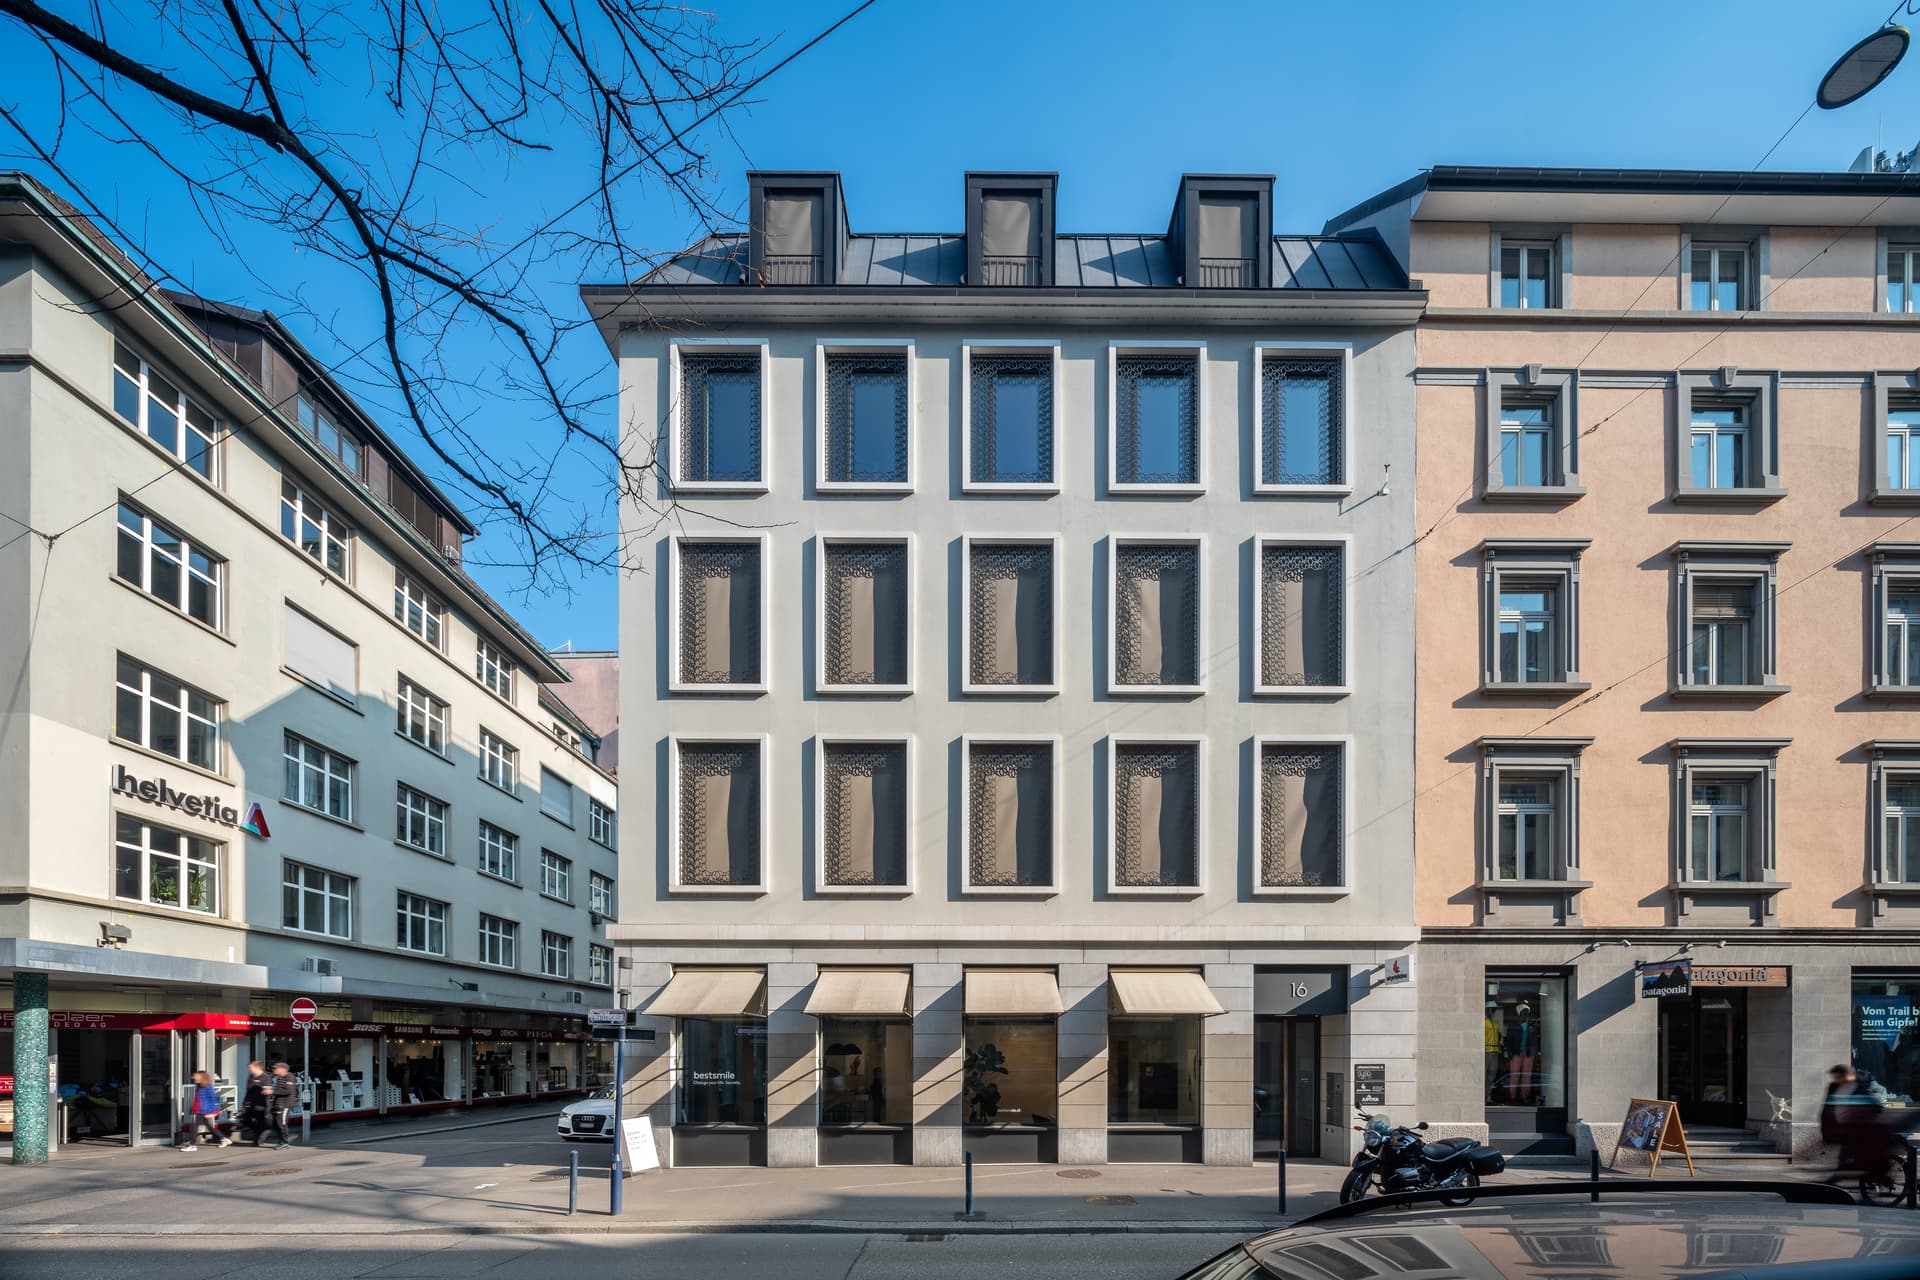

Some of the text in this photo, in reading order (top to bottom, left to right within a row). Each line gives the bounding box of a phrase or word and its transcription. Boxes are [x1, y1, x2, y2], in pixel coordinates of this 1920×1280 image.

[113, 764, 238, 824] helvetia
[1690, 967, 1768, 985] atagonia
[1290, 981, 1308, 998] 16
[1642, 984, 1687, 997] patagonia
[1862, 1006, 1920, 1016] Vom Trail b
[292, 1021, 331, 1030] SONY
[350, 1024, 386, 1032] BOSE
[1862, 1017, 1918, 1029] zum Gipfel
[693, 1071, 736, 1080] bestsmile
[1649, 1111, 1665, 1147] SALE
